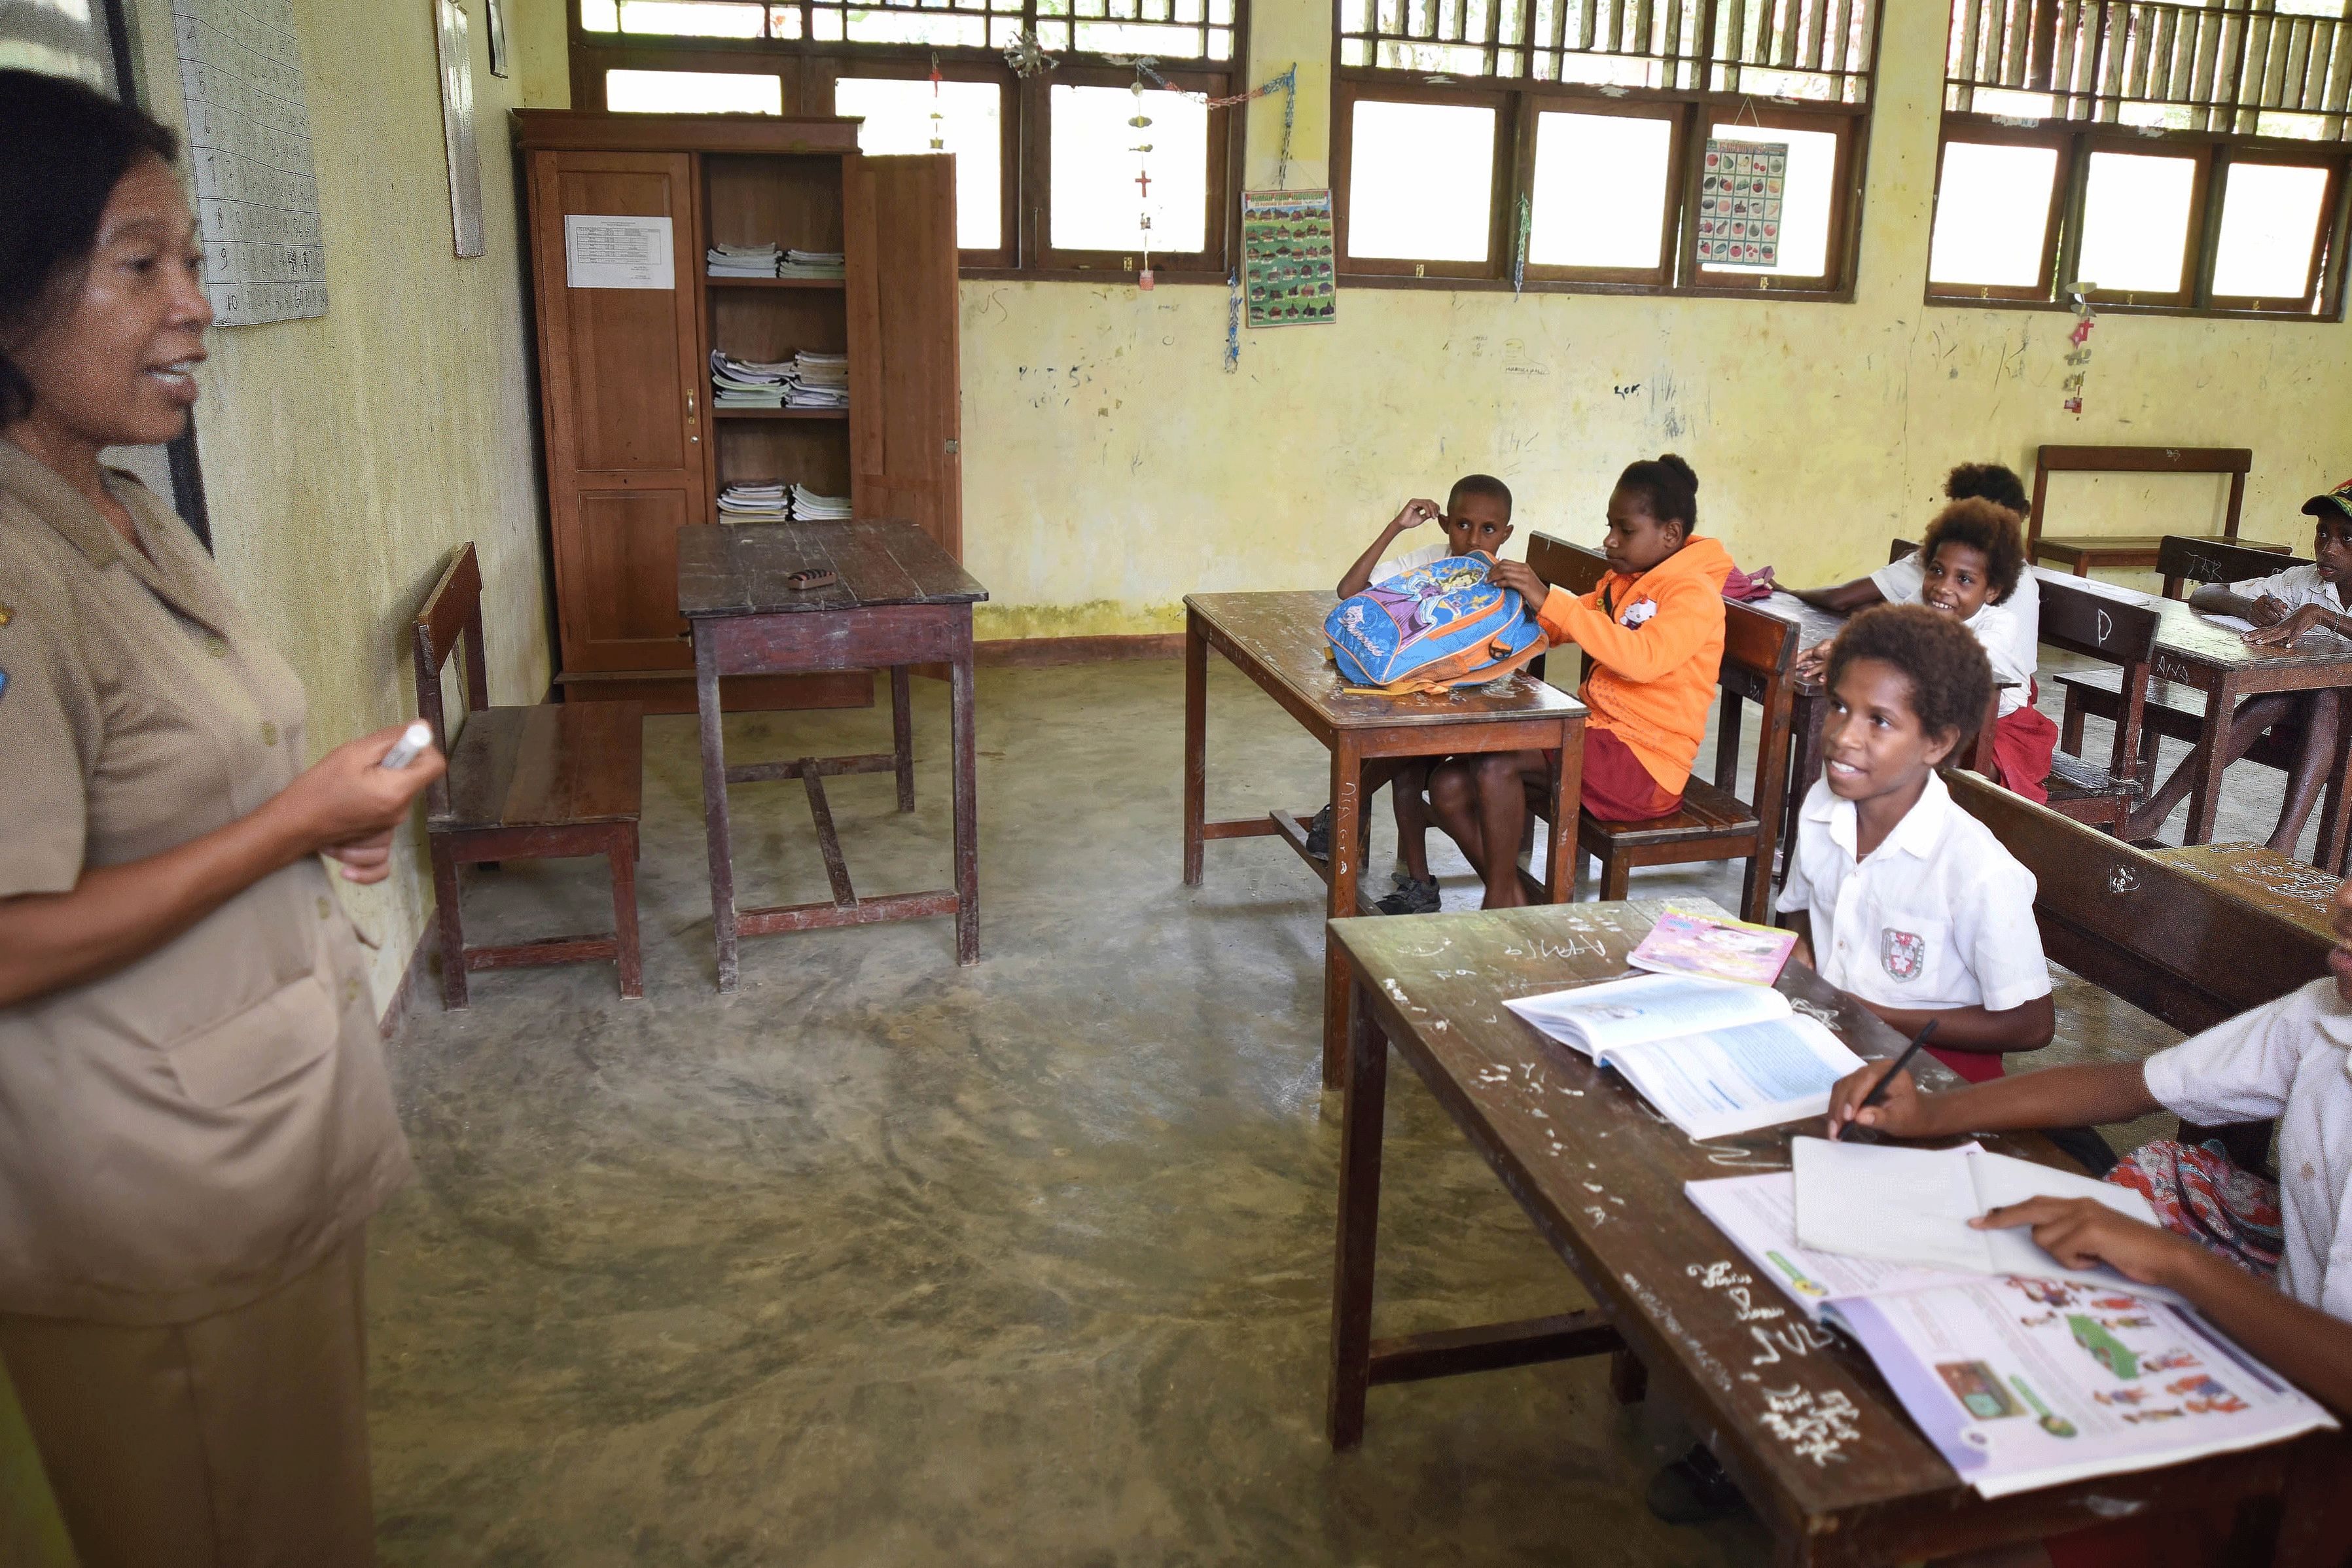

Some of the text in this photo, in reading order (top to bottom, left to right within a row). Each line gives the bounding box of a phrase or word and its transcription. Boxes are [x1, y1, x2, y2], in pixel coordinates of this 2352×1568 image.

[198, 71, 206, 96] 5
[1719, 141, 1764, 154] FRUITS
[1291, 192, 1325, 200] INDONESIA
[221, 247, 228, 271] 9
[226, 294, 238, 312] 10
